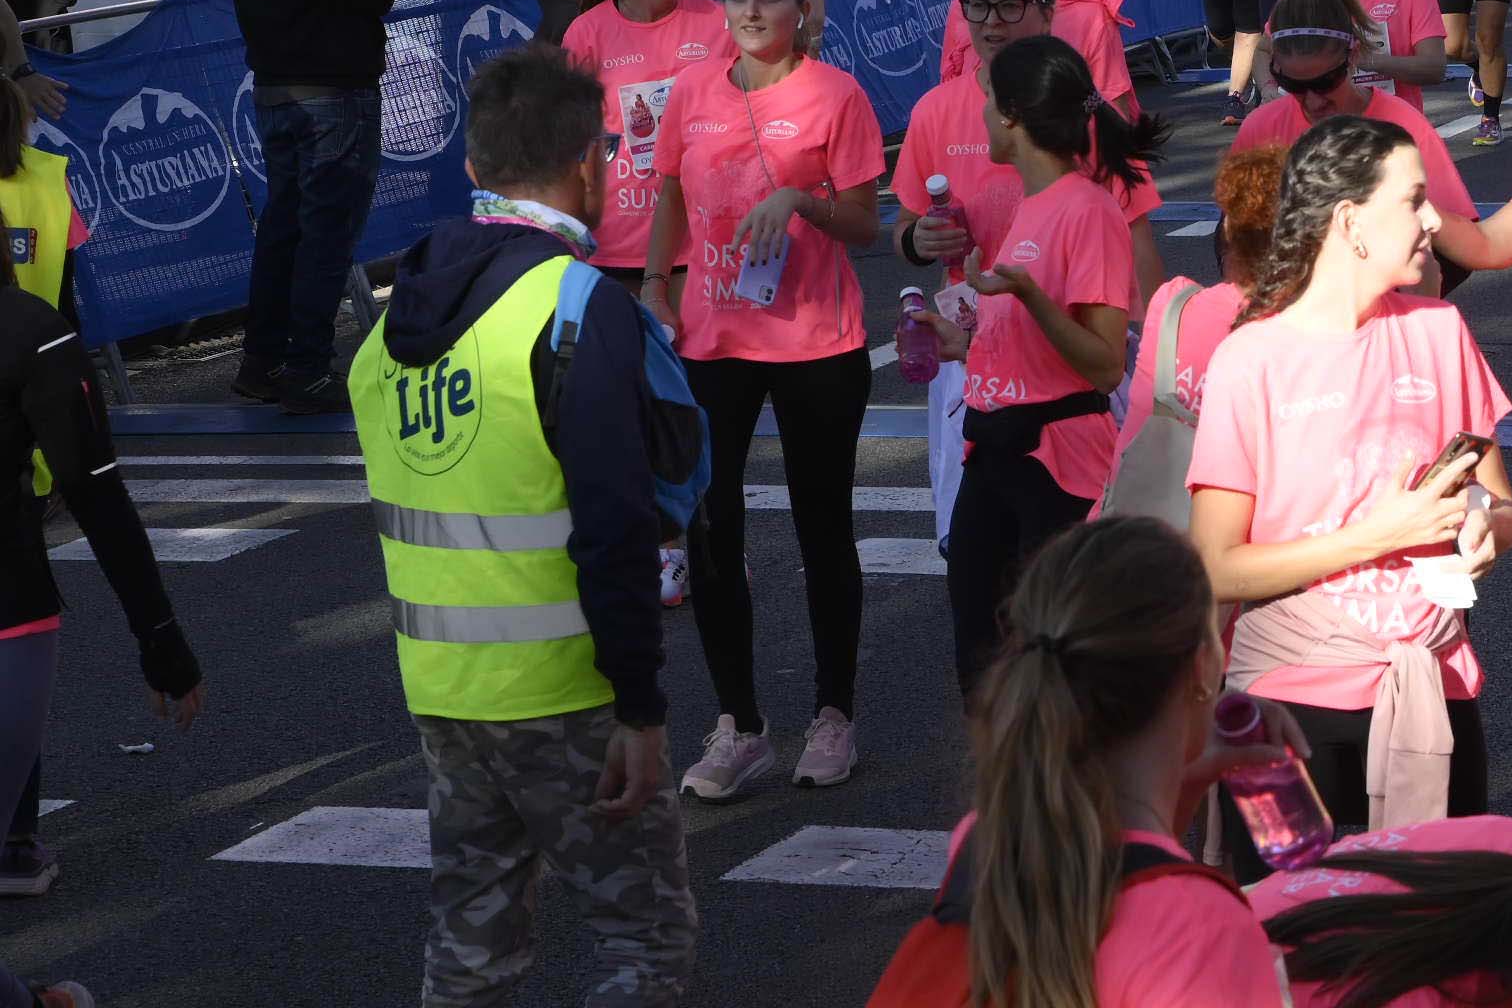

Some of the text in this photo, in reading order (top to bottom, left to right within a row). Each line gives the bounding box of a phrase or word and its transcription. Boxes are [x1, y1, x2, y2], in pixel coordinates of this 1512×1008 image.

[604, 53, 645, 69] OYSHO
[689, 123, 728, 134] OYSHO
[946, 143, 990, 156] OYSHO
[111, 142, 225, 203] ASTURIANA
[396, 356, 475, 444] Life
